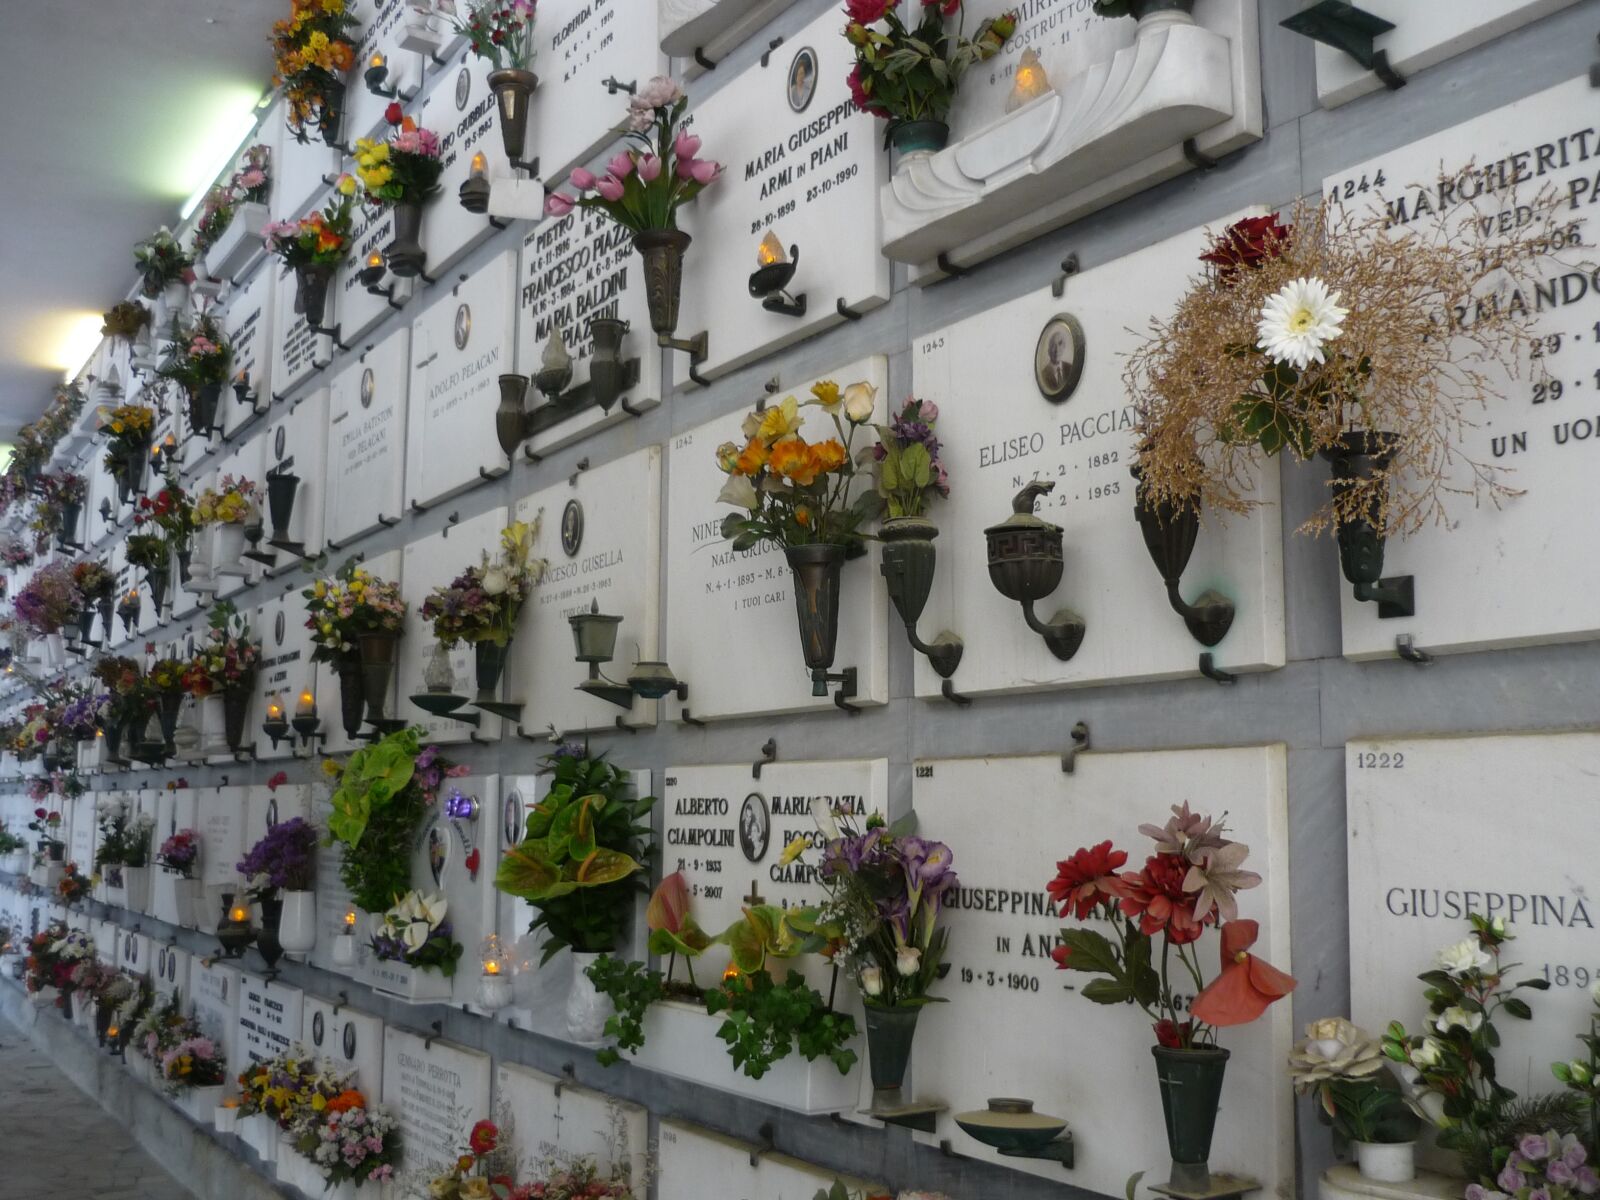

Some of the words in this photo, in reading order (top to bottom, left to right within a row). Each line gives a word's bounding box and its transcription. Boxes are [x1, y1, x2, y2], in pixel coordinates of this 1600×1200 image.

[744, 142, 786, 182] MARIA
[788, 97, 861, 152] GIUSEPPIN
[759, 165, 793, 202] ARMI
[810, 131, 849, 171] PIANI
[1384, 127, 1600, 230] MARGHERIT
[1331, 168, 1387, 202] 1244
[536, 213, 575, 254] PIETRO
[521, 245, 591, 309] FRANCESCO
[534, 301, 574, 344] MARIA
[576, 266, 628, 319] BALDINI
[922, 337, 945, 355] 1243
[1532, 379, 1563, 405] 29
[675, 435, 693, 450] 1242
[979, 431, 1044, 469] ELISEO
[1491, 431, 1527, 458] UN
[1553, 415, 1600, 445] UO
[1012, 474, 1025, 489] N.
[1087, 451, 1120, 469] 1882
[1087, 481, 1121, 501] 1963
[533, 562, 578, 588] ANCESCO
[581, 548, 624, 574] GUSELLA
[711, 550, 737, 568] NATA
[764, 590, 786, 605] CARI
[1357, 752, 1405, 769] 1222
[675, 797, 729, 816] ALBERTO
[667, 828, 736, 848] CIAMPOLINI
[1386, 886, 1594, 929] GIUSEPPINA
[996, 936, 1010, 953] IN
[1540, 963, 1600, 989] 189
